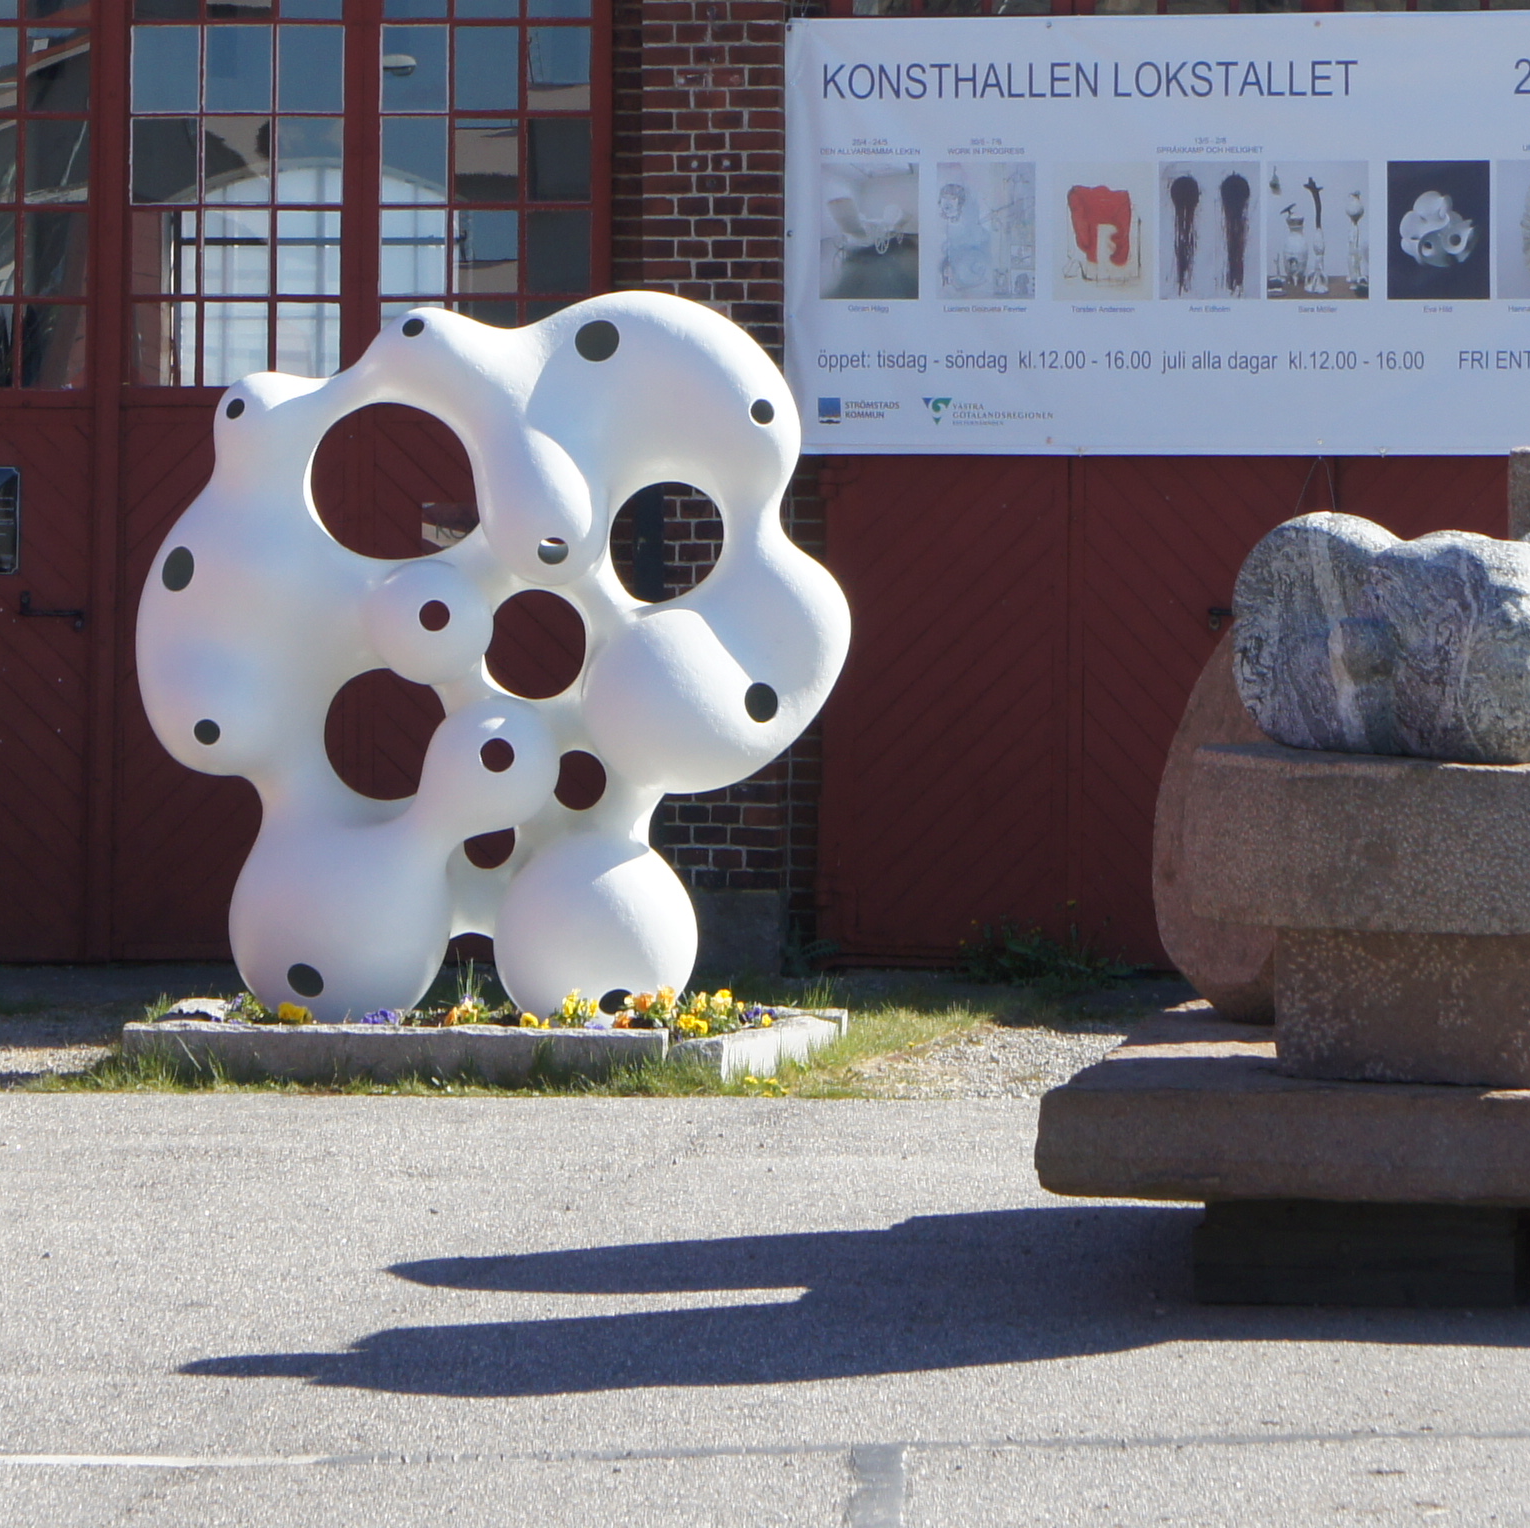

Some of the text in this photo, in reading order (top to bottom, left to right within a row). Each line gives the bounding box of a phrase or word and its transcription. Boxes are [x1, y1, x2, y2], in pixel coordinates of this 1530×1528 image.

[821, 60, 1359, 99] KONSTHALLEN LOKSTALLET
[819, 147, 921, 155] DEN ALLVARSAMMA LEKEN
[947, 147, 1025, 155] WORK IN PROGRESS
[1205, 146, 1224, 154] OCH
[1225, 146, 1264, 154] HELIGHET
[817, 350, 871, 374] öppet:
[876, 350, 928, 374] tisdag
[945, 350, 1008, 374] söndag
[1018, 350, 1086, 370] kl.12.00
[1105, 350, 1152, 370] 16.00
[1161, 350, 1186, 374] juli
[1191, 350, 1222, 370] alla
[1227, 350, 1279, 374] dagar
[1288, 350, 1357, 370] kl.12.00
[1375, 350, 1425, 370] 16.00
[1457, 350, 1489, 370] FRI
[844, 399, 901, 410] STRÖMSTADS
[844, 410, 885, 419] KOMMUN
[952, 410, 1054, 420] GÖTALANDSREGIONEN
